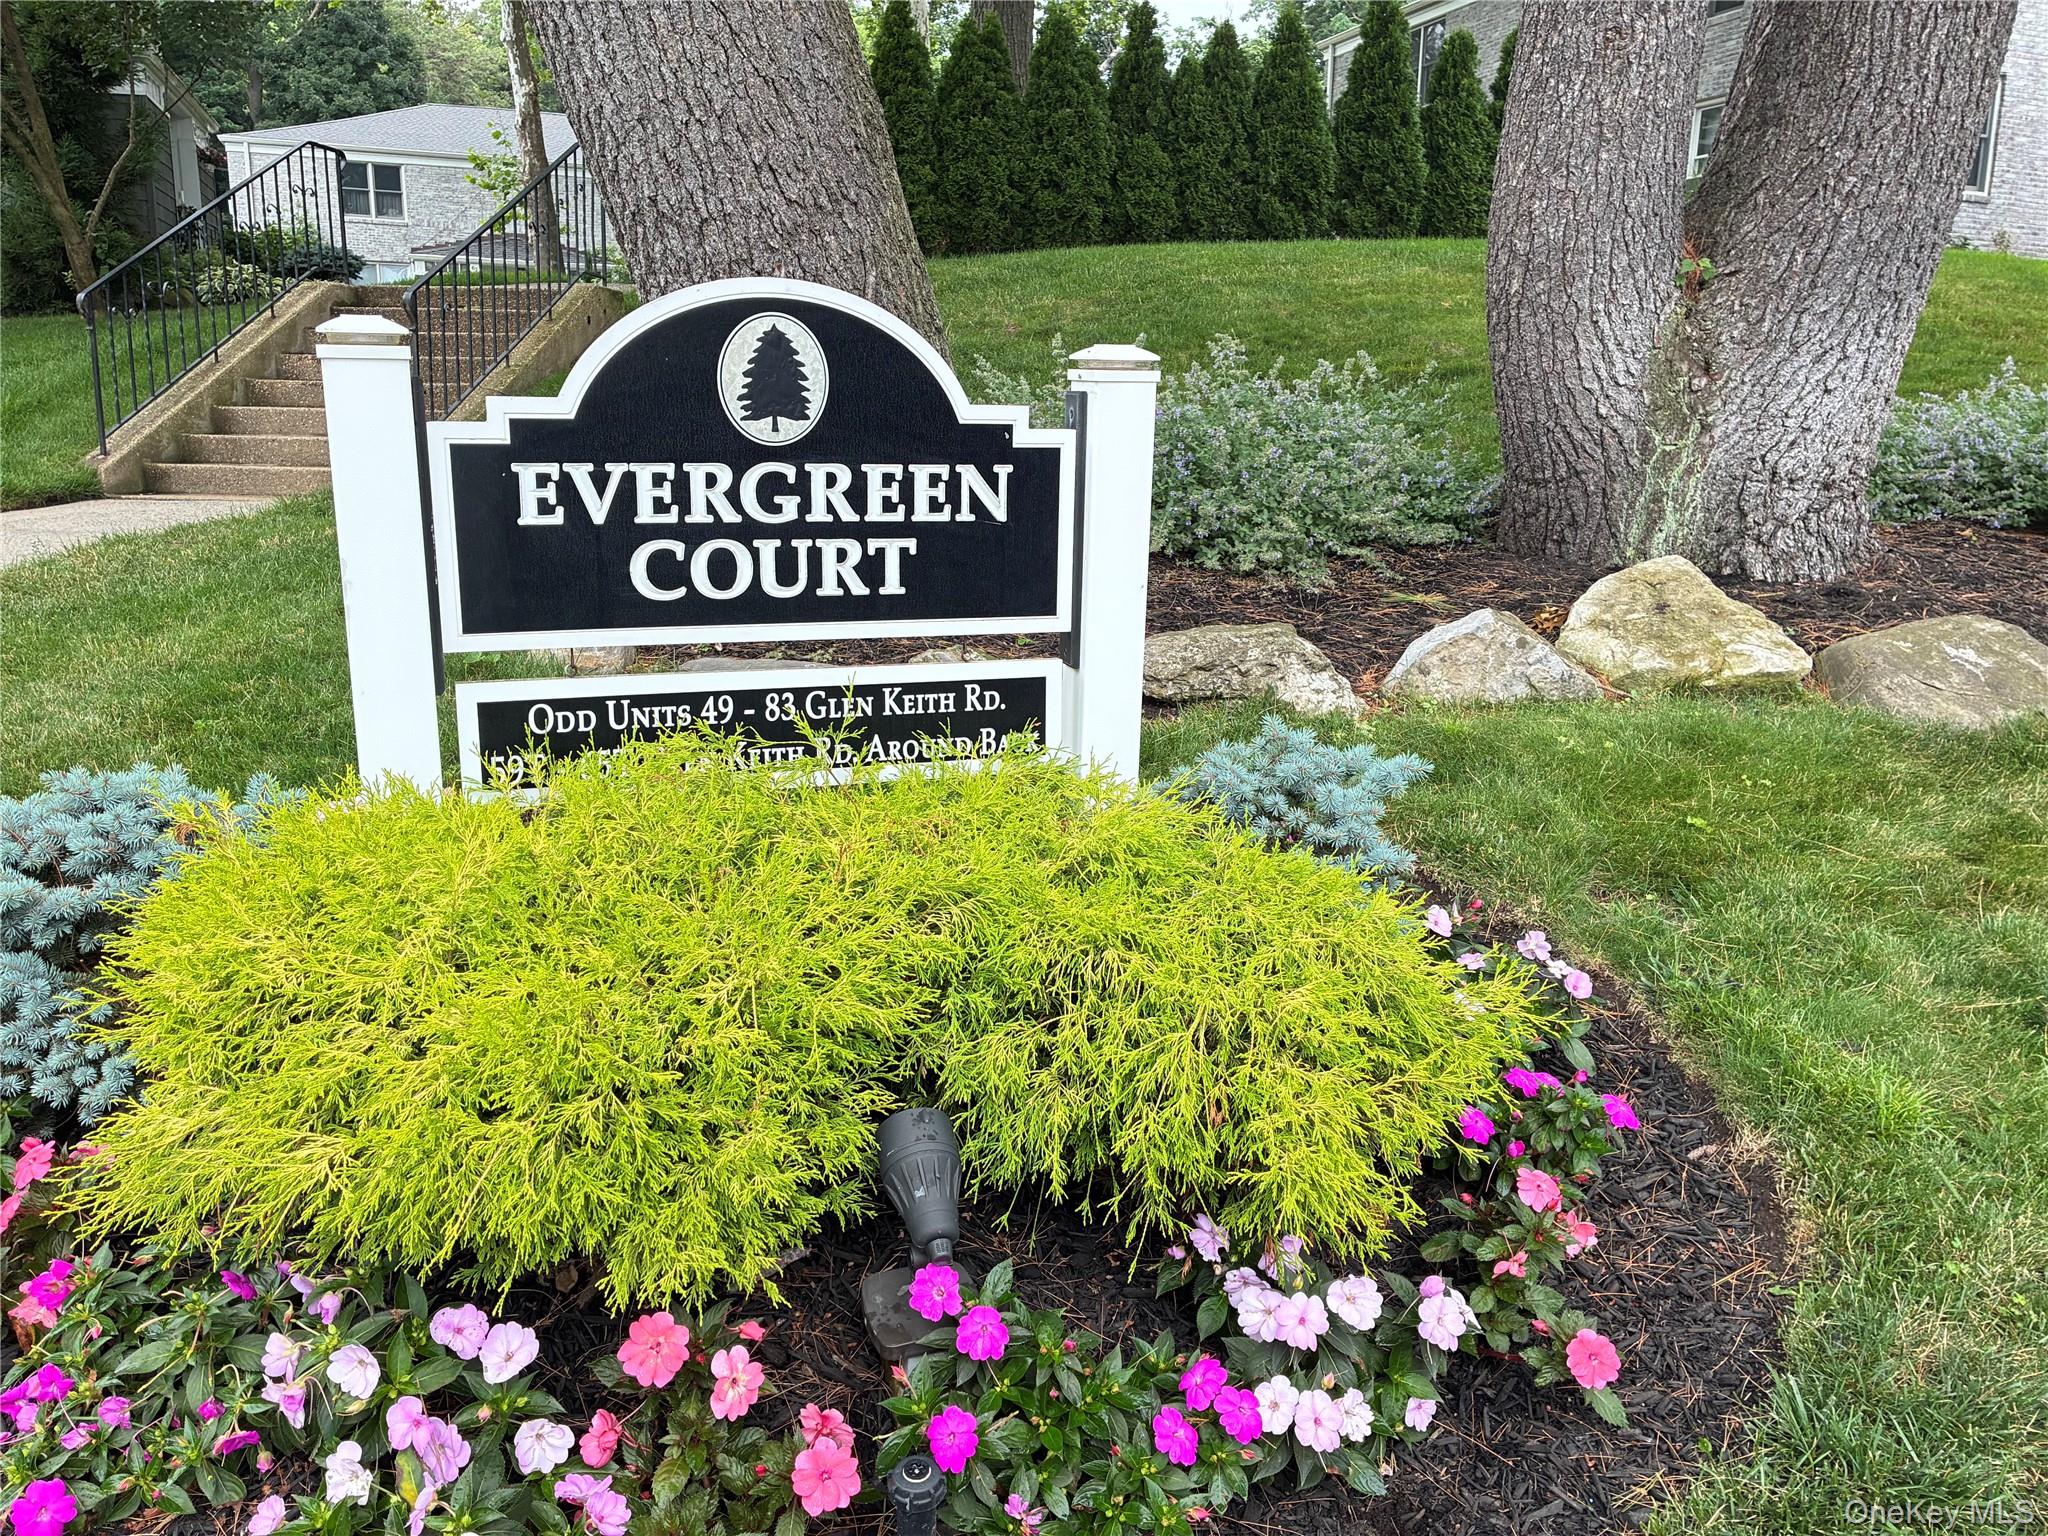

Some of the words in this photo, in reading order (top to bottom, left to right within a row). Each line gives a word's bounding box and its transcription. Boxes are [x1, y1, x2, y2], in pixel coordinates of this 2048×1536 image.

[511, 462, 1013, 525] EVERGREEN
[629, 537, 917, 600] COURT
[528, 703, 596, 734] ODD
[606, 699, 692, 731] UNITS
[700, 695, 734, 725] 49
[765, 691, 796, 721] 83
[805, 690, 874, 719] GLEN
[882, 687, 956, 715] KEITH
[965, 684, 1006, 711] RD.
